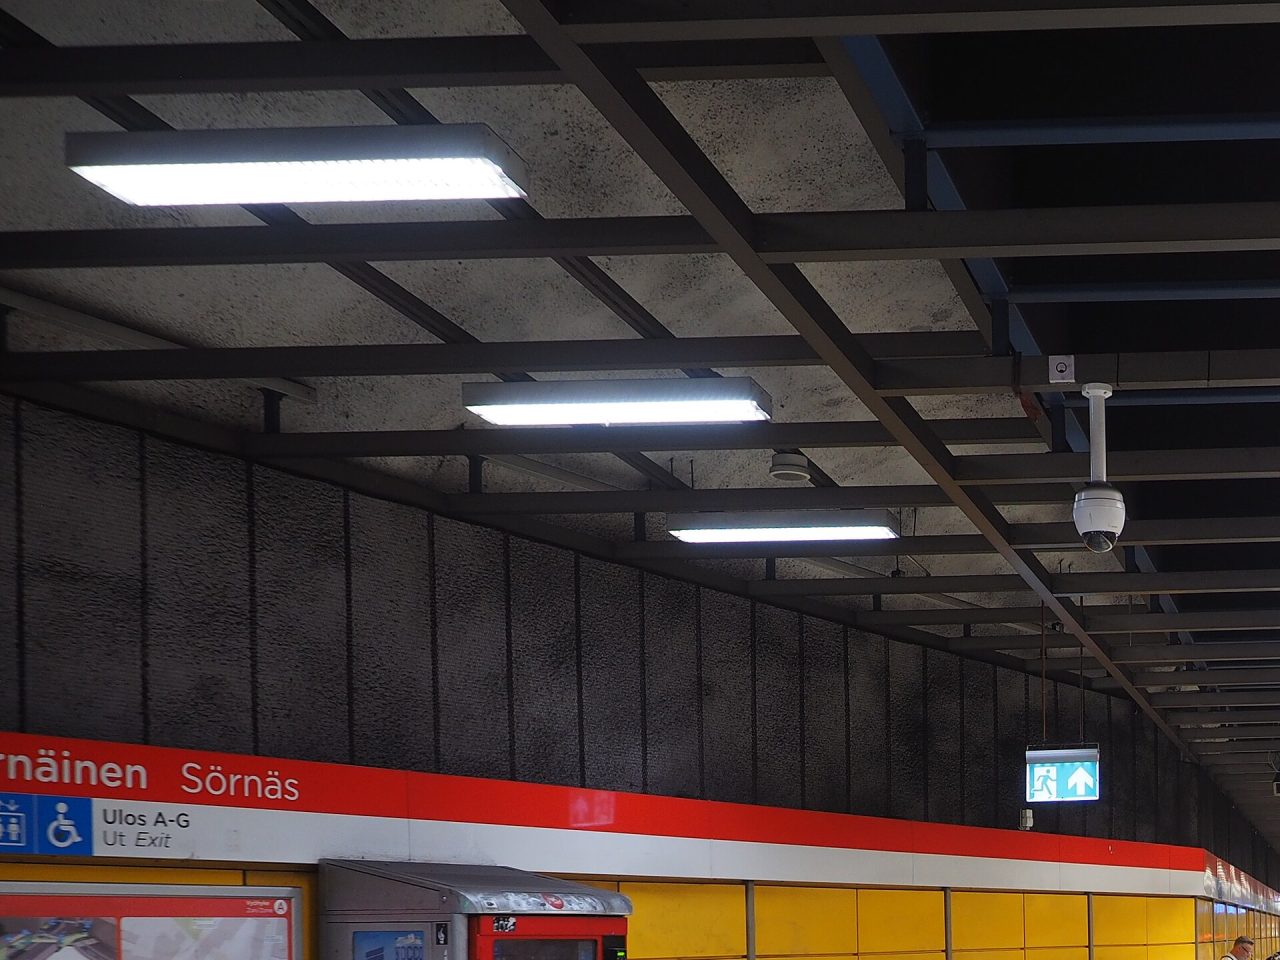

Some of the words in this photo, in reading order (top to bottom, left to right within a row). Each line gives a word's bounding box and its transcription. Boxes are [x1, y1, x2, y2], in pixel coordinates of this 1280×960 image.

[180, 762, 300, 801] Sörnäs
[103, 808, 147, 827] Ulos
[153, 811, 190, 828] A-G
[103, 830, 126, 847] Ut
[135, 831, 172, 848] Exit
